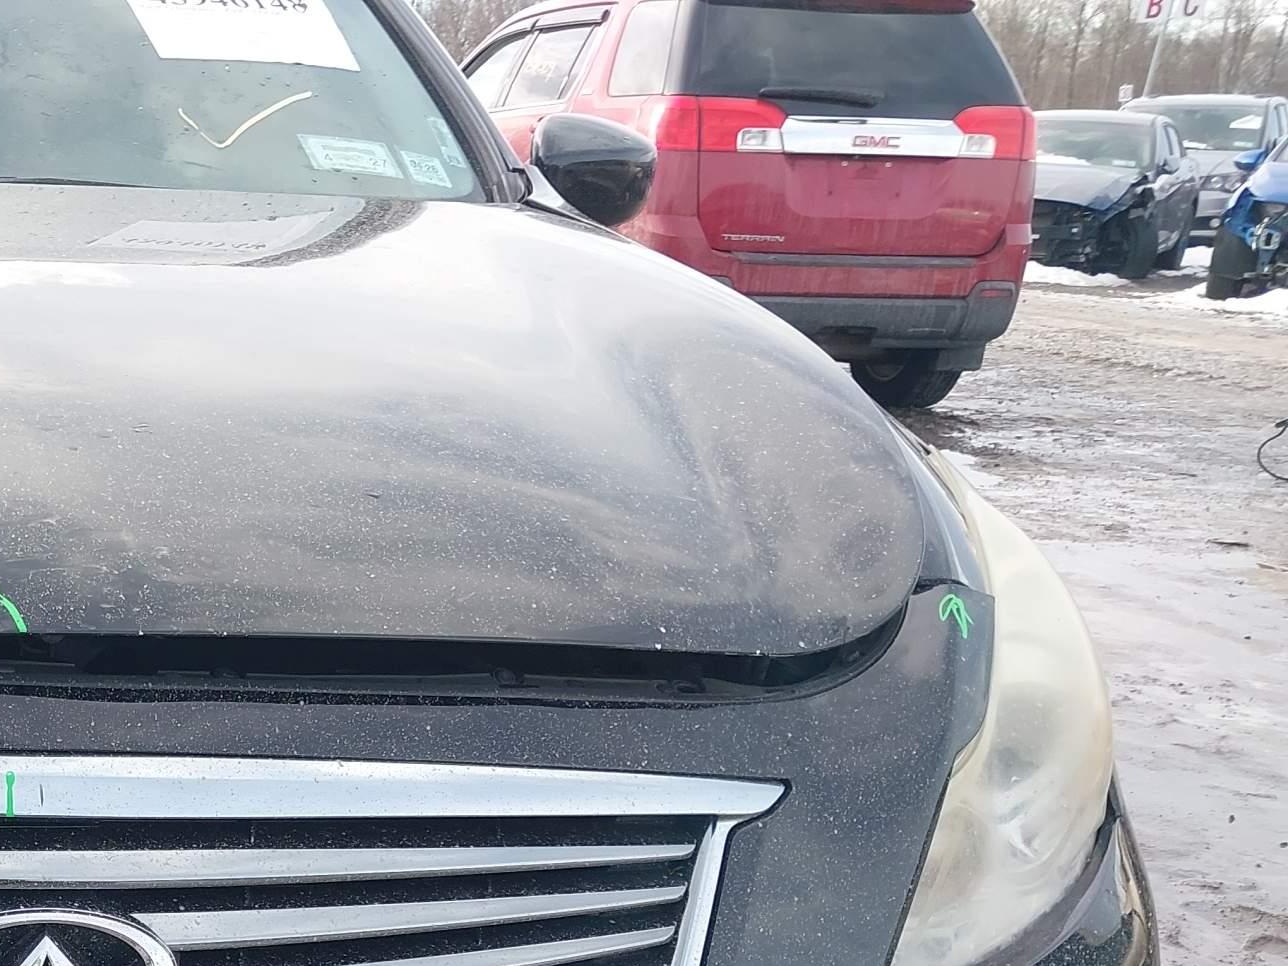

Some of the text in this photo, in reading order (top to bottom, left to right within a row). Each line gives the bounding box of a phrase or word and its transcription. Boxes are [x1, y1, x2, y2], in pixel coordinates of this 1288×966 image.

[1146, 0, 1163, 19] B
[851, 135, 901, 149] GMC
[721, 233, 785, 243] TERRAIN
